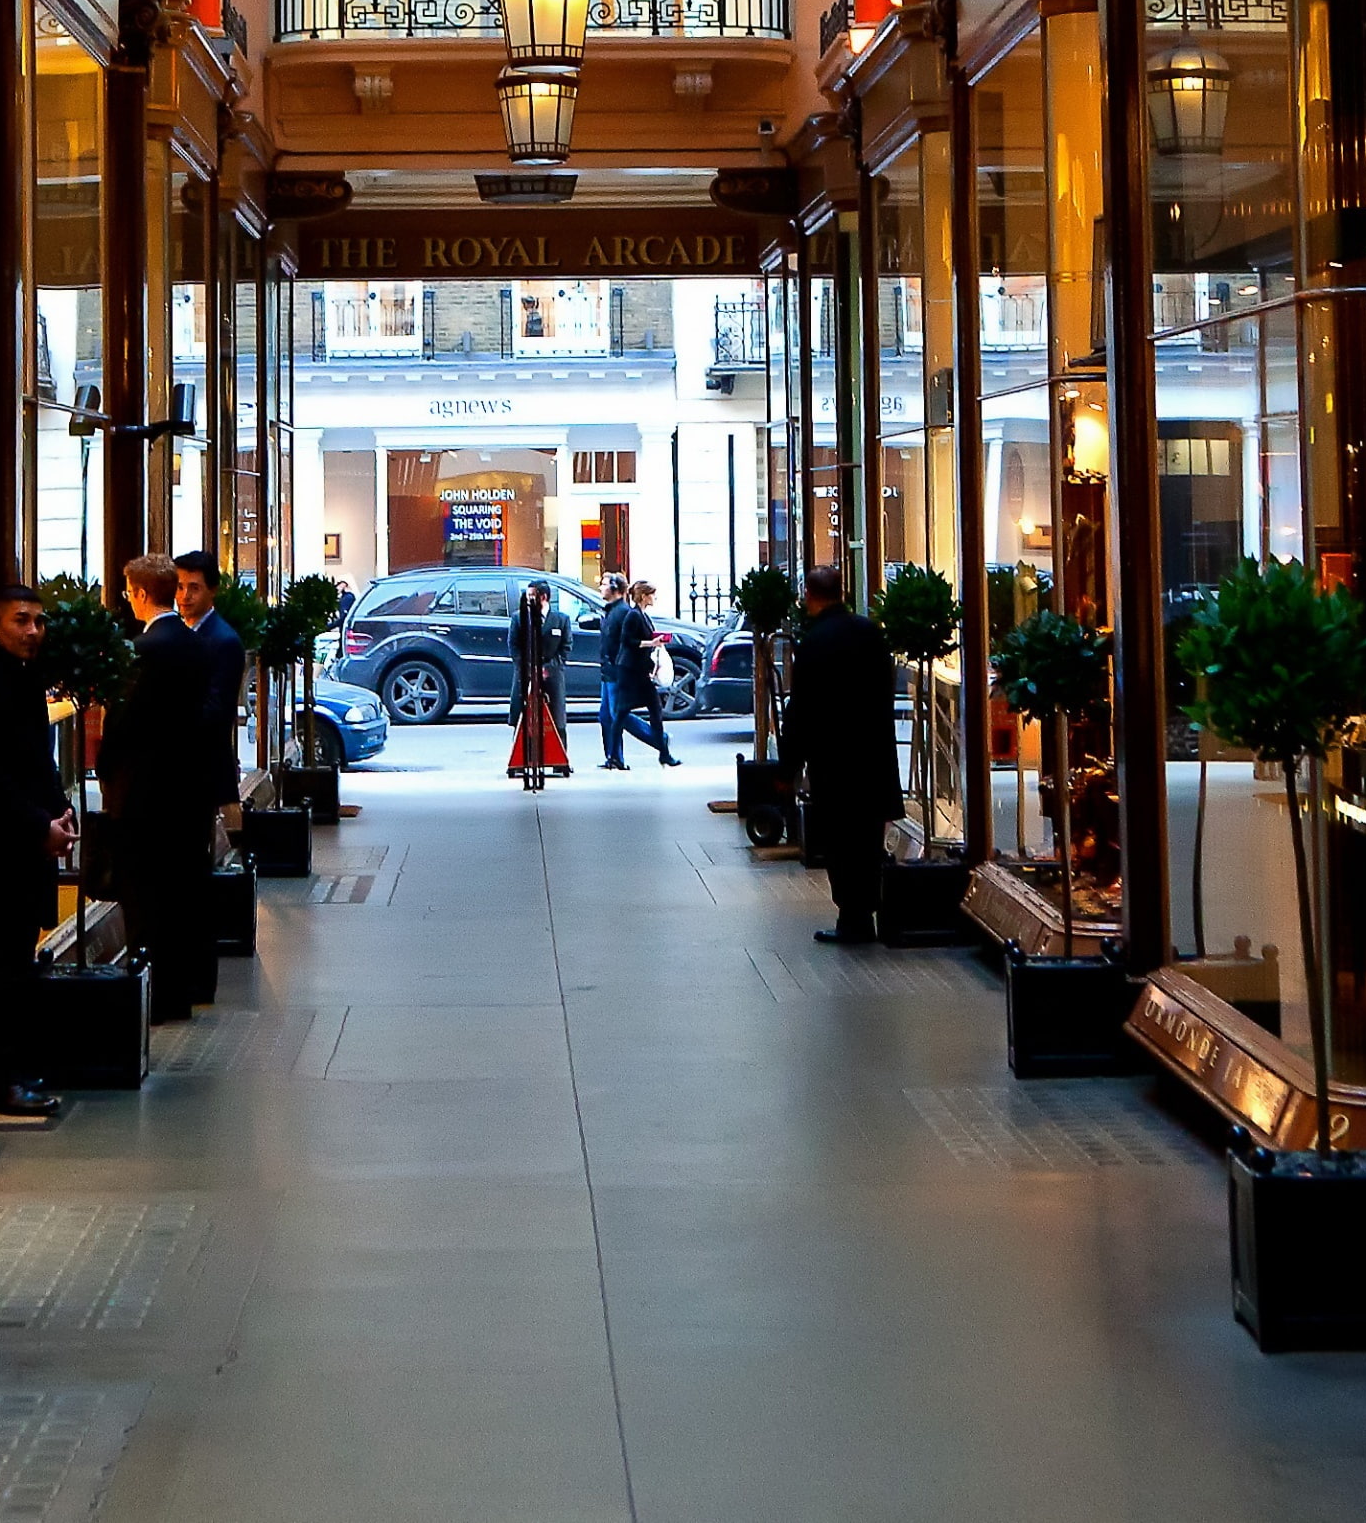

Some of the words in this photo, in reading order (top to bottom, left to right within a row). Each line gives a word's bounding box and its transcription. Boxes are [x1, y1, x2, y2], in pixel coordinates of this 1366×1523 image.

[314, 237, 398, 268] THE
[423, 236, 561, 268] ROYAL
[584, 235, 746, 267] ARCADE
[440, 488, 469, 500] JOHN
[471, 488, 515, 500] HOLDEN
[452, 504, 502, 515] SQUARING
[452, 518, 474, 529] THE
[475, 518, 502, 529] VOID
[485, 531, 506, 540] March
[1144, 999, 1220, 1070] ORMONDE
